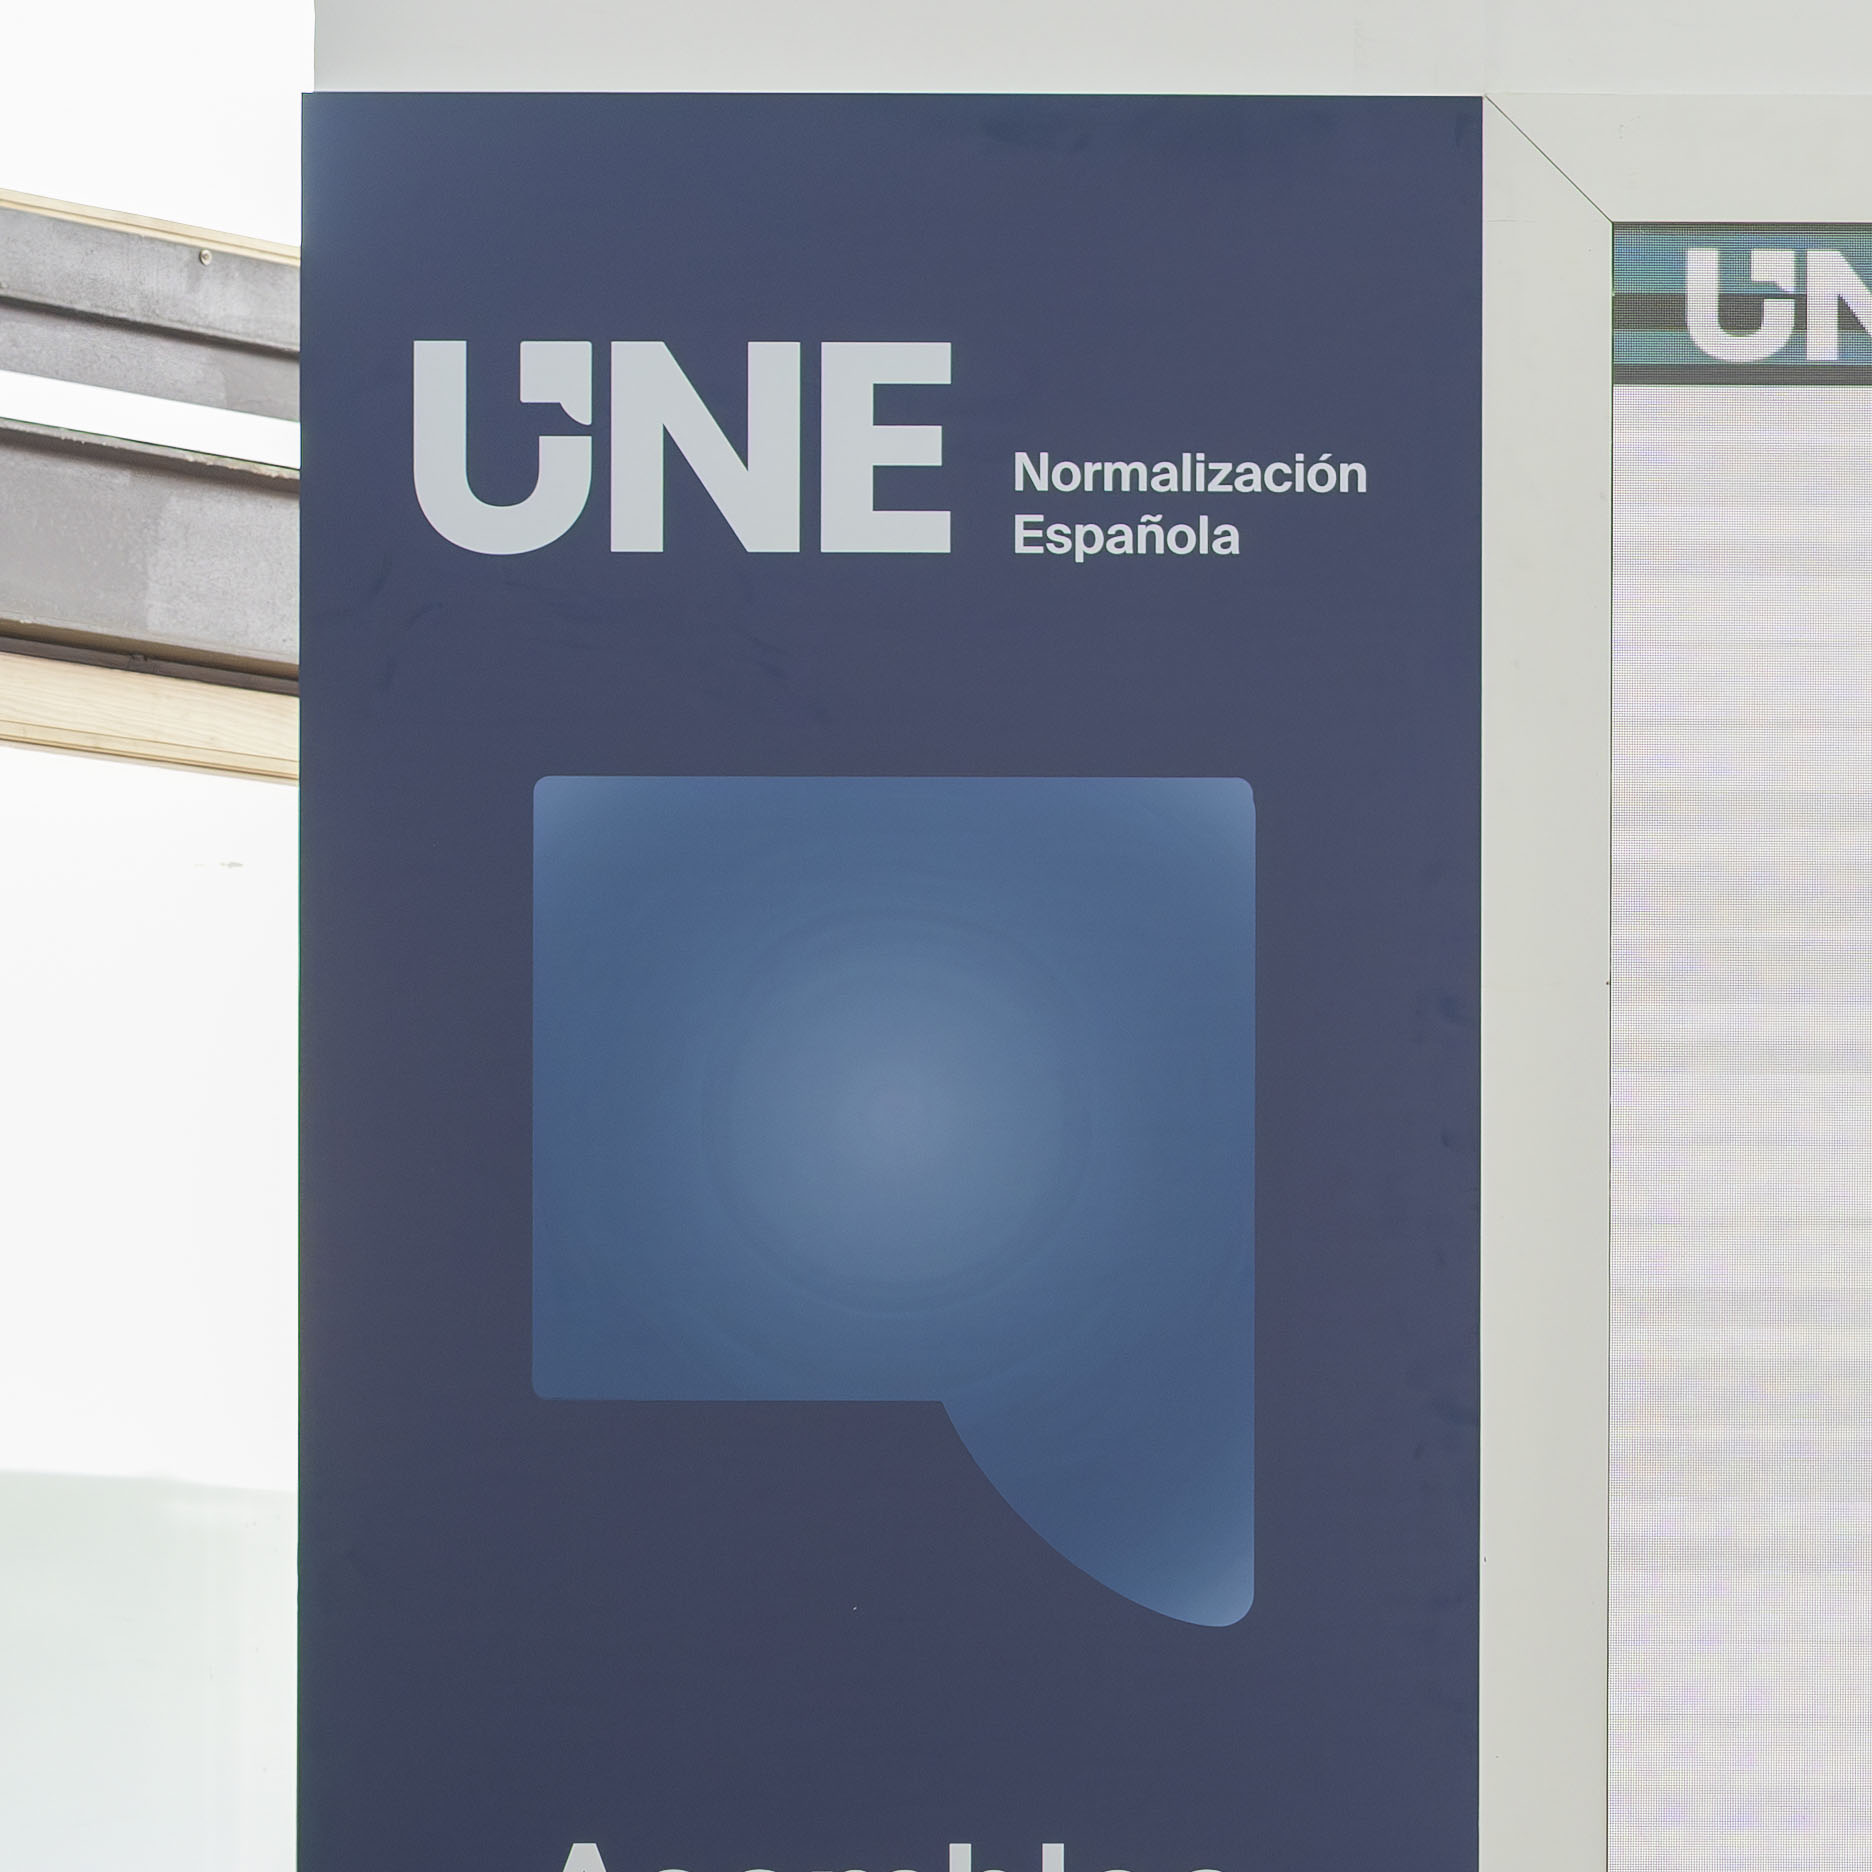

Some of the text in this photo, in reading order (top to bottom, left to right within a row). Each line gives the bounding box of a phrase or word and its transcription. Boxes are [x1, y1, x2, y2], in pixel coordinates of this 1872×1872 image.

[414, 341, 951, 554] UNE
[1015, 452, 1366, 492] Normalización
[1015, 515, 1239, 562] Española
